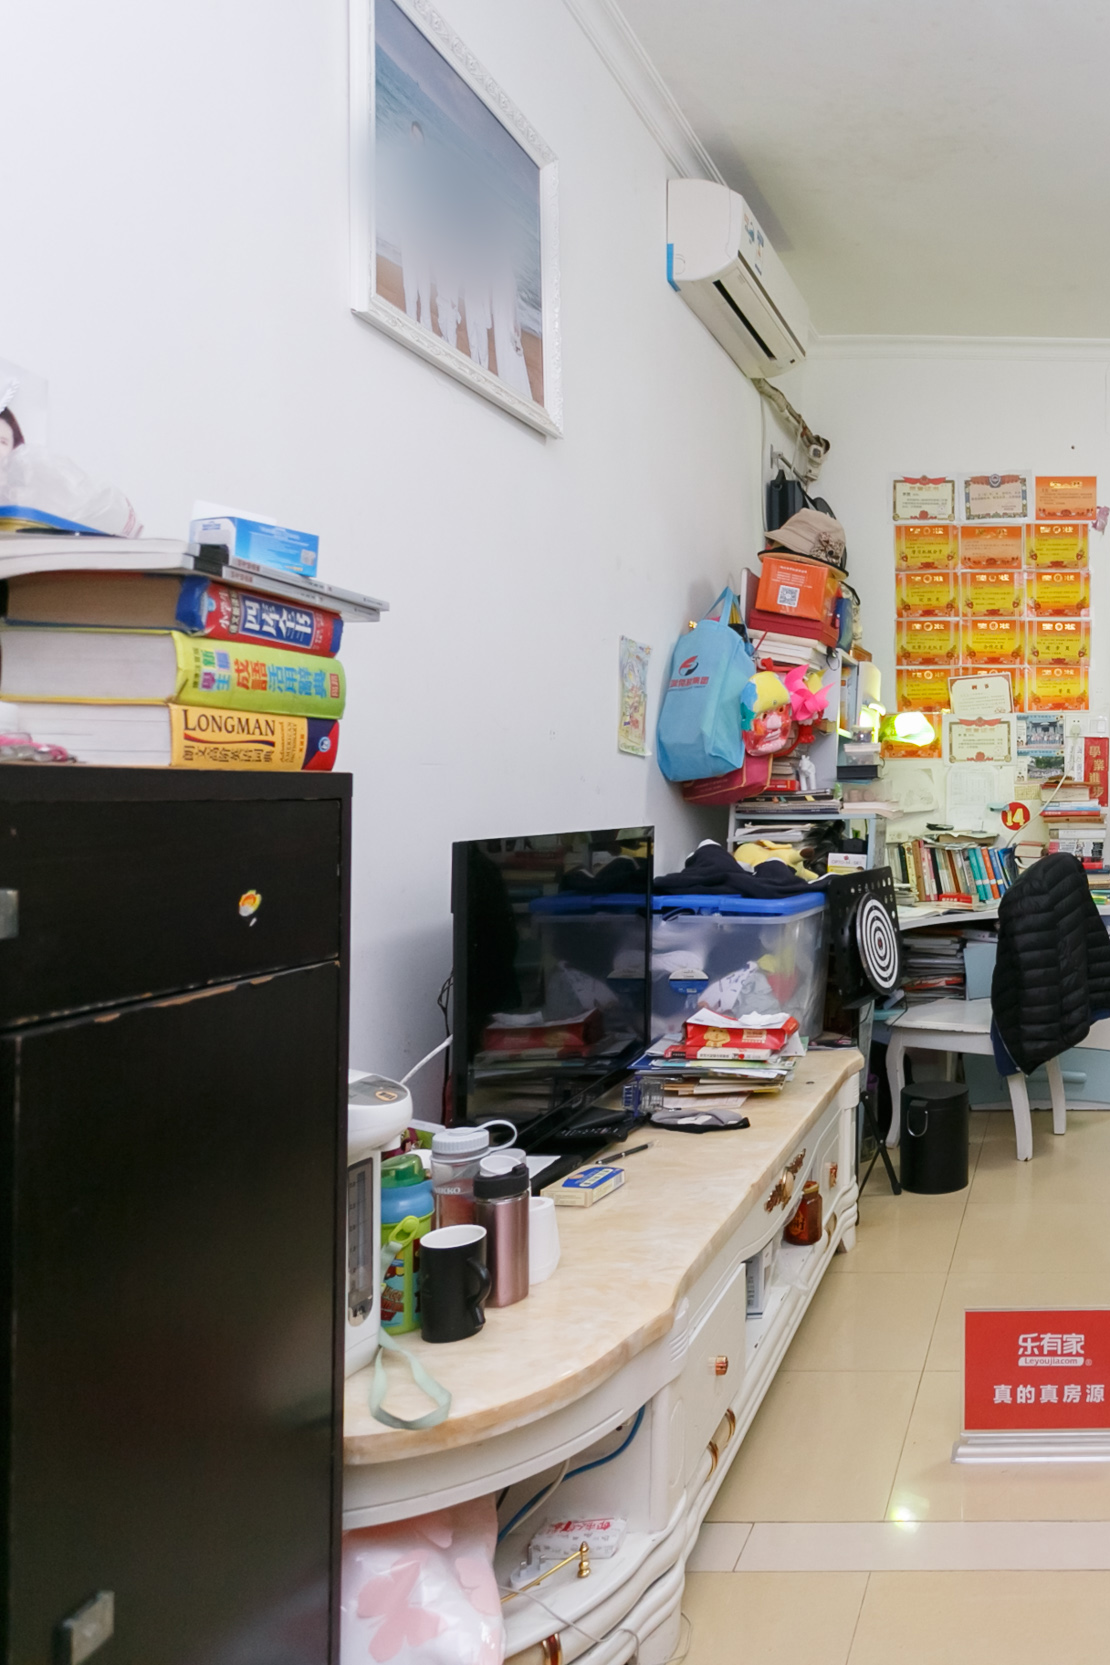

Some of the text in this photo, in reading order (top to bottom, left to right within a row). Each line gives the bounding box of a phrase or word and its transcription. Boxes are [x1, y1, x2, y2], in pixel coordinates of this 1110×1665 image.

[244, 600, 312, 638] 四库全书
[182, 709, 275, 736] LONGMAN
[183, 745, 274, 763] 朗文高阶英语词典
[1006, 808, 1025, 827] 14
[1018, 1333, 1085, 1355] 乐有家
[993, 1384, 1105, 1404] 真的真房源
